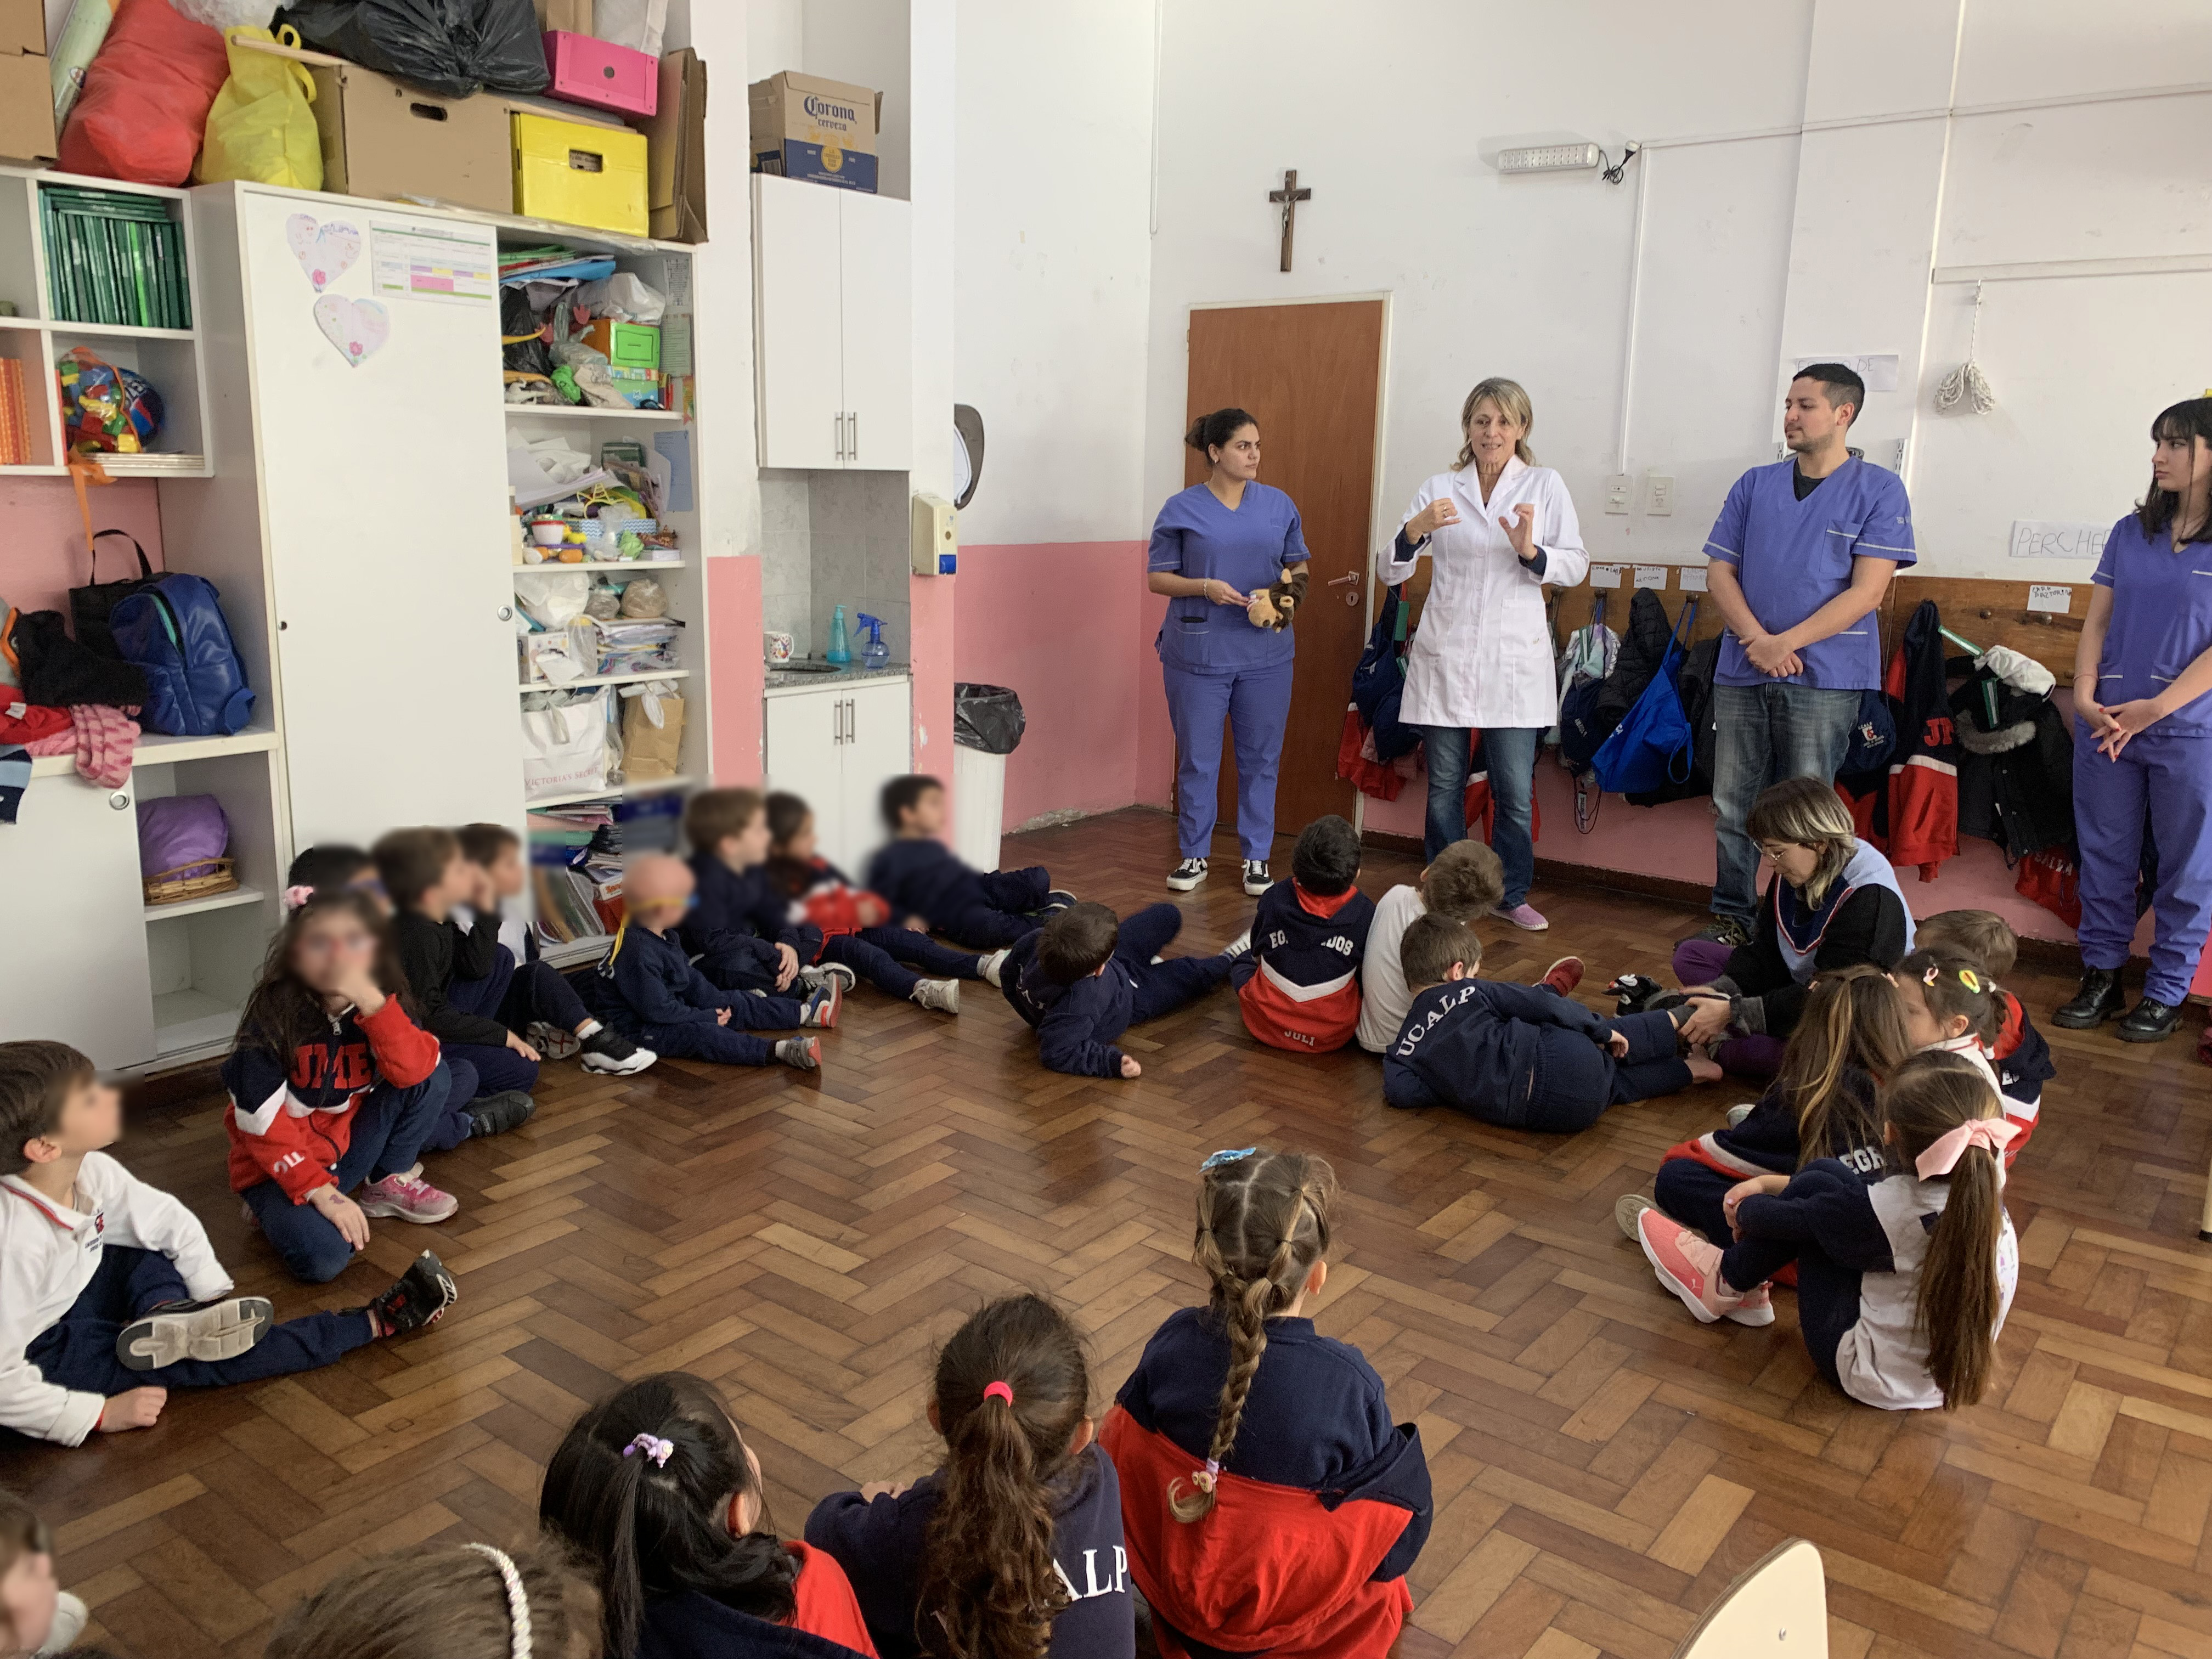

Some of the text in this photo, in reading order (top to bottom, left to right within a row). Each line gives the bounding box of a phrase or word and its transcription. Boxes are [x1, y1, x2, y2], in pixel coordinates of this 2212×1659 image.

[804, 95, 857, 124] Corona
[817, 118, 847, 131] cerveza
[1857, 358, 1874, 372] DE
[524, 766, 597, 786] VICTORIA'S SECRET
[1396, 985, 1476, 1056] UCALP
[1284, 1030, 1315, 1047] JULI
